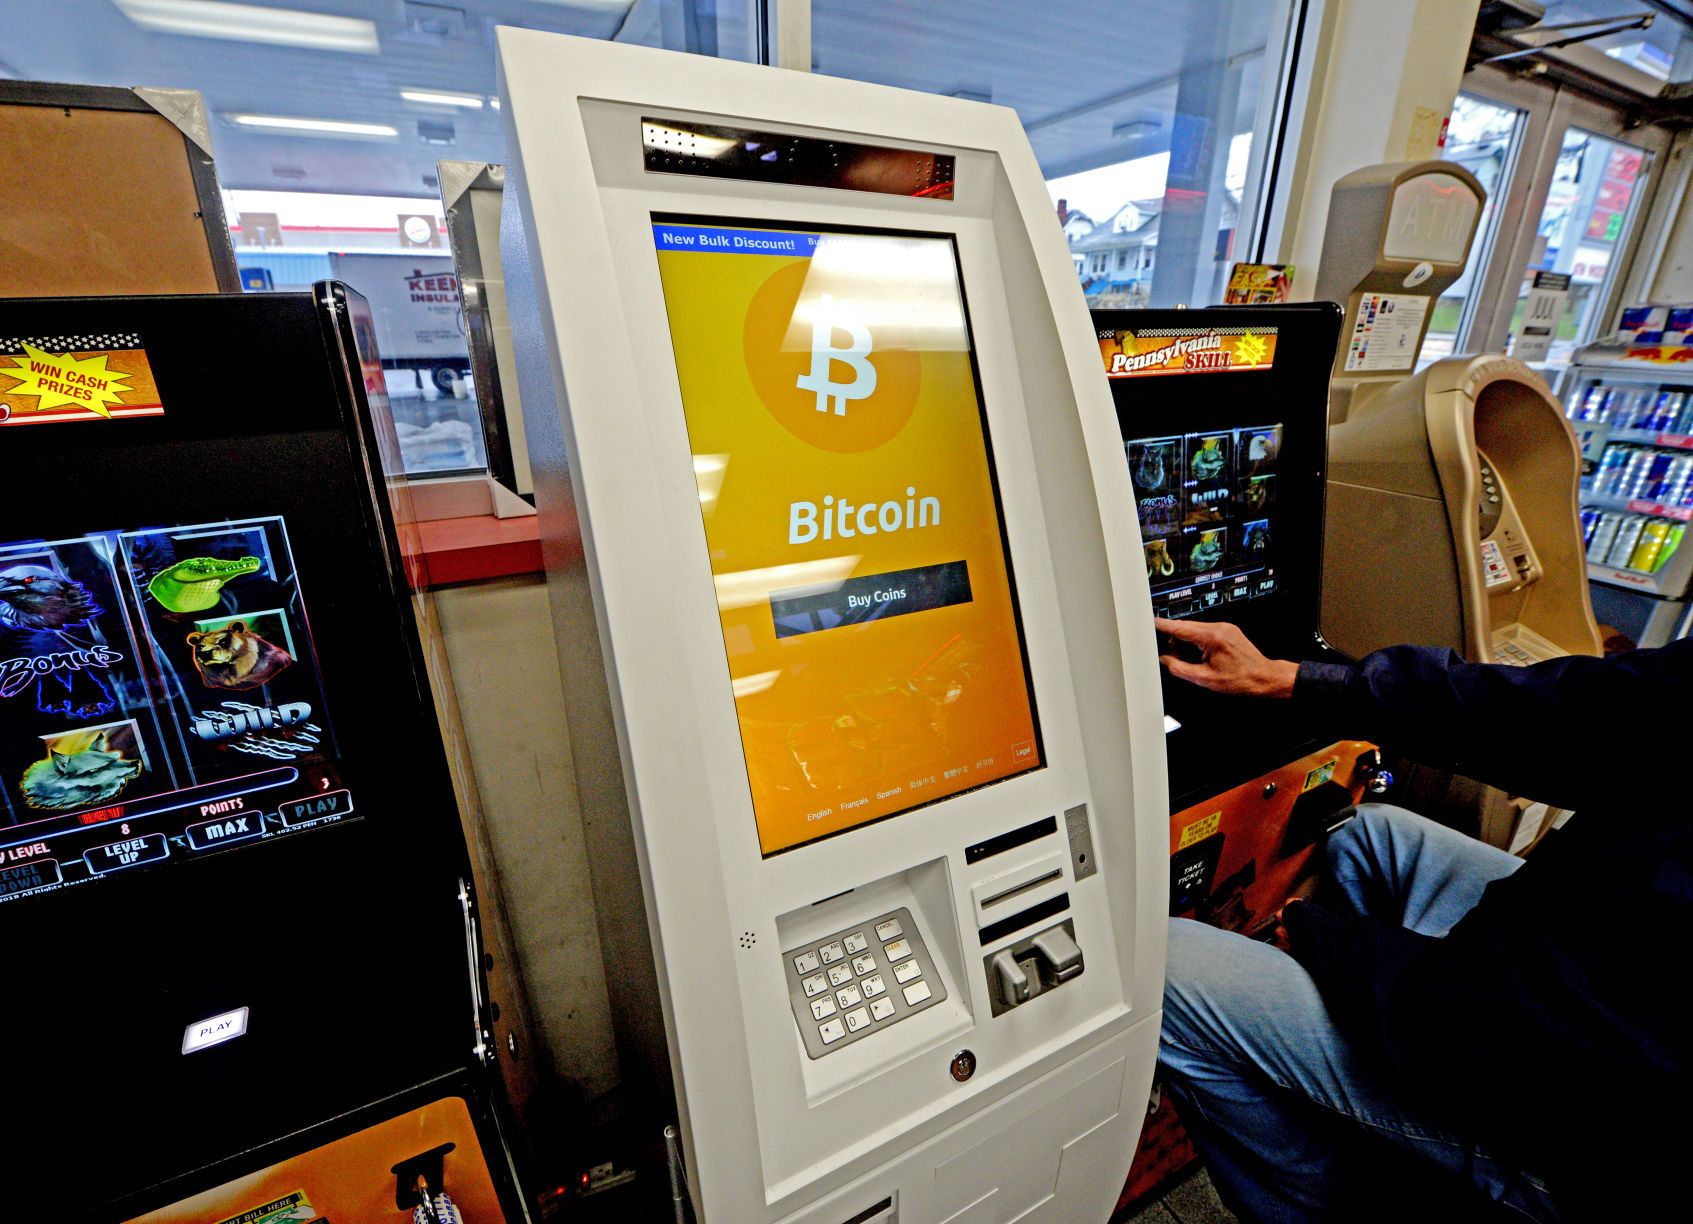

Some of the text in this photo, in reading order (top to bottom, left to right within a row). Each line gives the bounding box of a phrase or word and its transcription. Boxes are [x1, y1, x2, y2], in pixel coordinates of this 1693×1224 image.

[663, 233, 695, 245] New
[699, 234, 730, 247] Bulk
[734, 237, 796, 250] Discount!
[1111, 330, 1222, 374] Pennsylvania
[1184, 351, 1233, 372] SKILL
[30, 361, 108, 391] WIN CASH
[38, 378, 93, 400] PRIZES
[789, 486, 941, 544] Bitcoin
[1260, 580, 1274, 590] PLAY
[848, 588, 906, 608] Buy Coins
[1016, 746, 1031, 756] Legal
[321, 778, 330, 789] 3
[200, 798, 244, 817] POINTS
[295, 797, 337, 818] PLAY
[807, 786, 902, 821] English Français Spanish
[121, 823, 130, 835] 8
[205, 817, 250, 840] MAX
[8, 842, 50, 860] LEVEL
[104, 839, 148, 857] LEVEL
[118, 852, 139, 865] UP
[0, 865, 39, 882] EVEL
[1184, 861, 1204, 874] TAKE
[35, 885, 62, 895] Rights
[64, 874, 106, 887] Reserved.
[1178, 868, 1205, 885] TICKET
[848, 942, 855, 951] 3
[886, 942, 901, 951] CLEAR
[824, 952, 831, 961] 2
[800, 962, 806, 971] 1
[857, 963, 864, 972] 6
[832, 974, 840, 983] 5
[808, 984, 814, 992] 4
[865, 985, 873, 994] 9
[841, 996, 848, 1006] 8
[815, 1006, 821, 1016] 7
[200, 1020, 232, 1037] PLAY
[849, 1016, 856, 1027] 0
[244, 1210, 264, 1221] BILL
[268, 1198, 292, 1212] HERE
